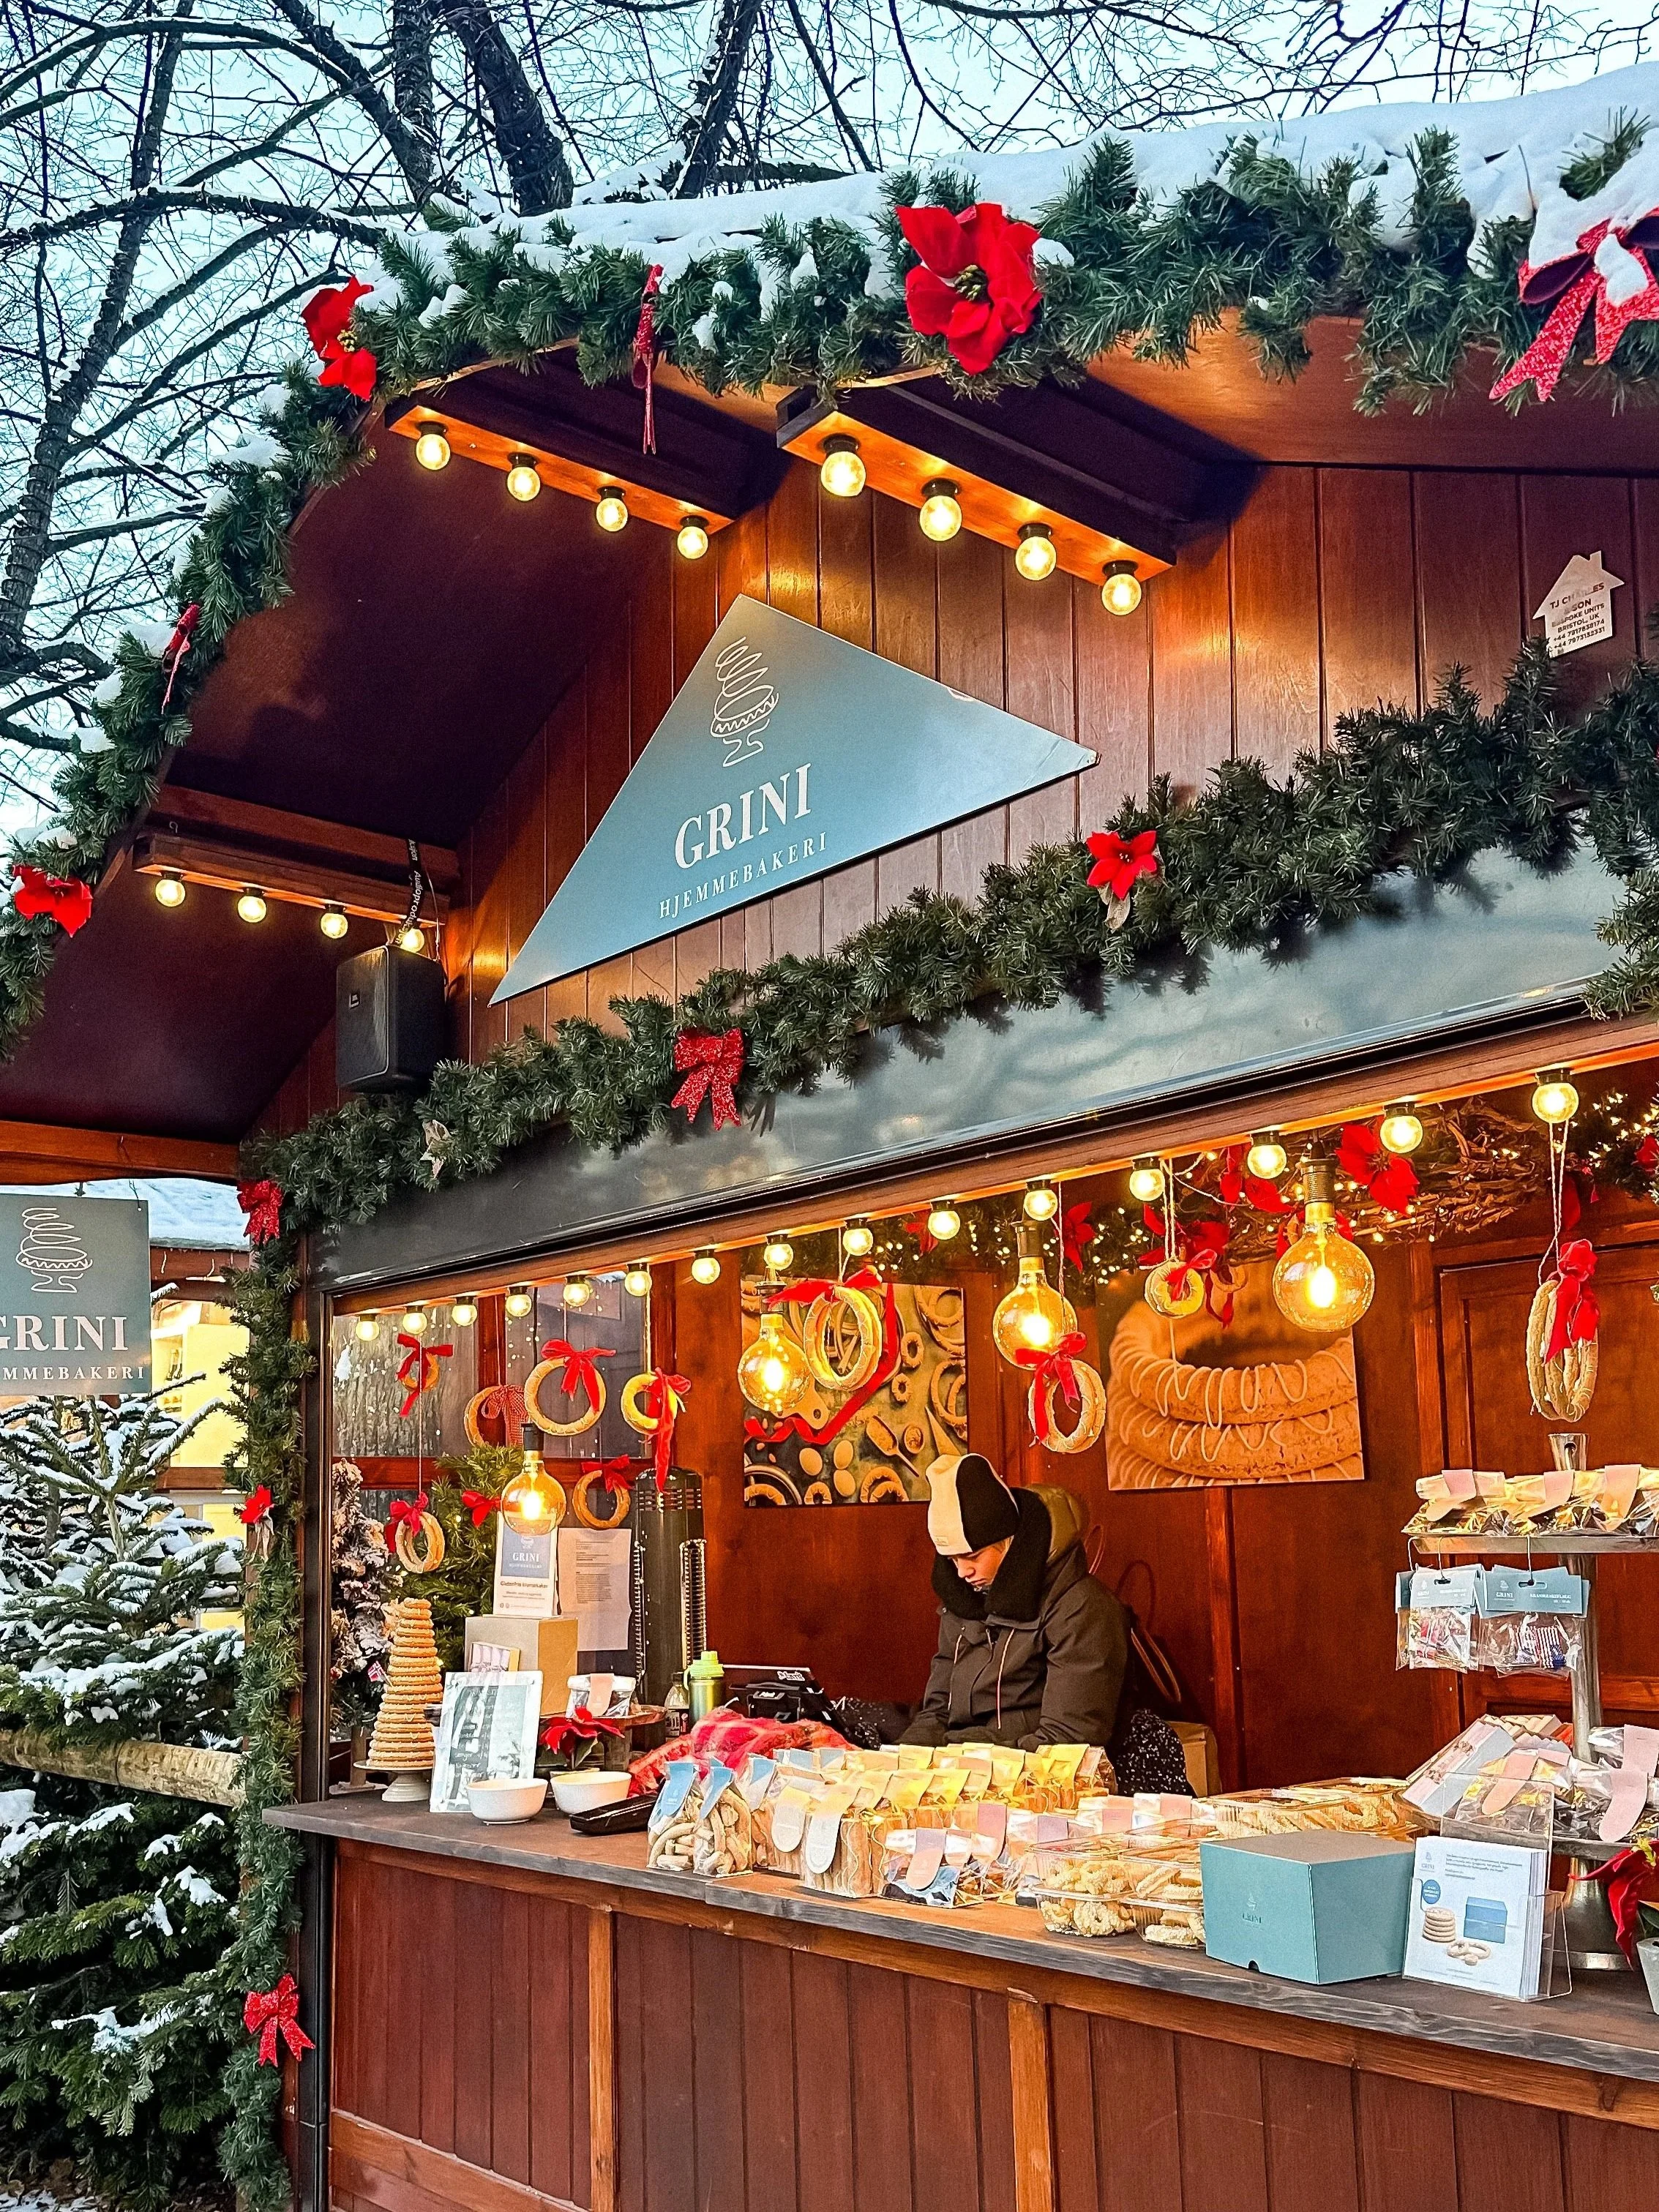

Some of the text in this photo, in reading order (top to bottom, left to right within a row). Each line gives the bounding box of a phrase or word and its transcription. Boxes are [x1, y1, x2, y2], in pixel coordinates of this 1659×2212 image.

[1550, 600, 1559, 609] TJ
[1572, 599, 1592, 611] SON
[675, 762, 812, 869] GRINI
[659, 831, 827, 918] HJEMMEBAKERI
[512, 1552, 539, 1562] GRINI
